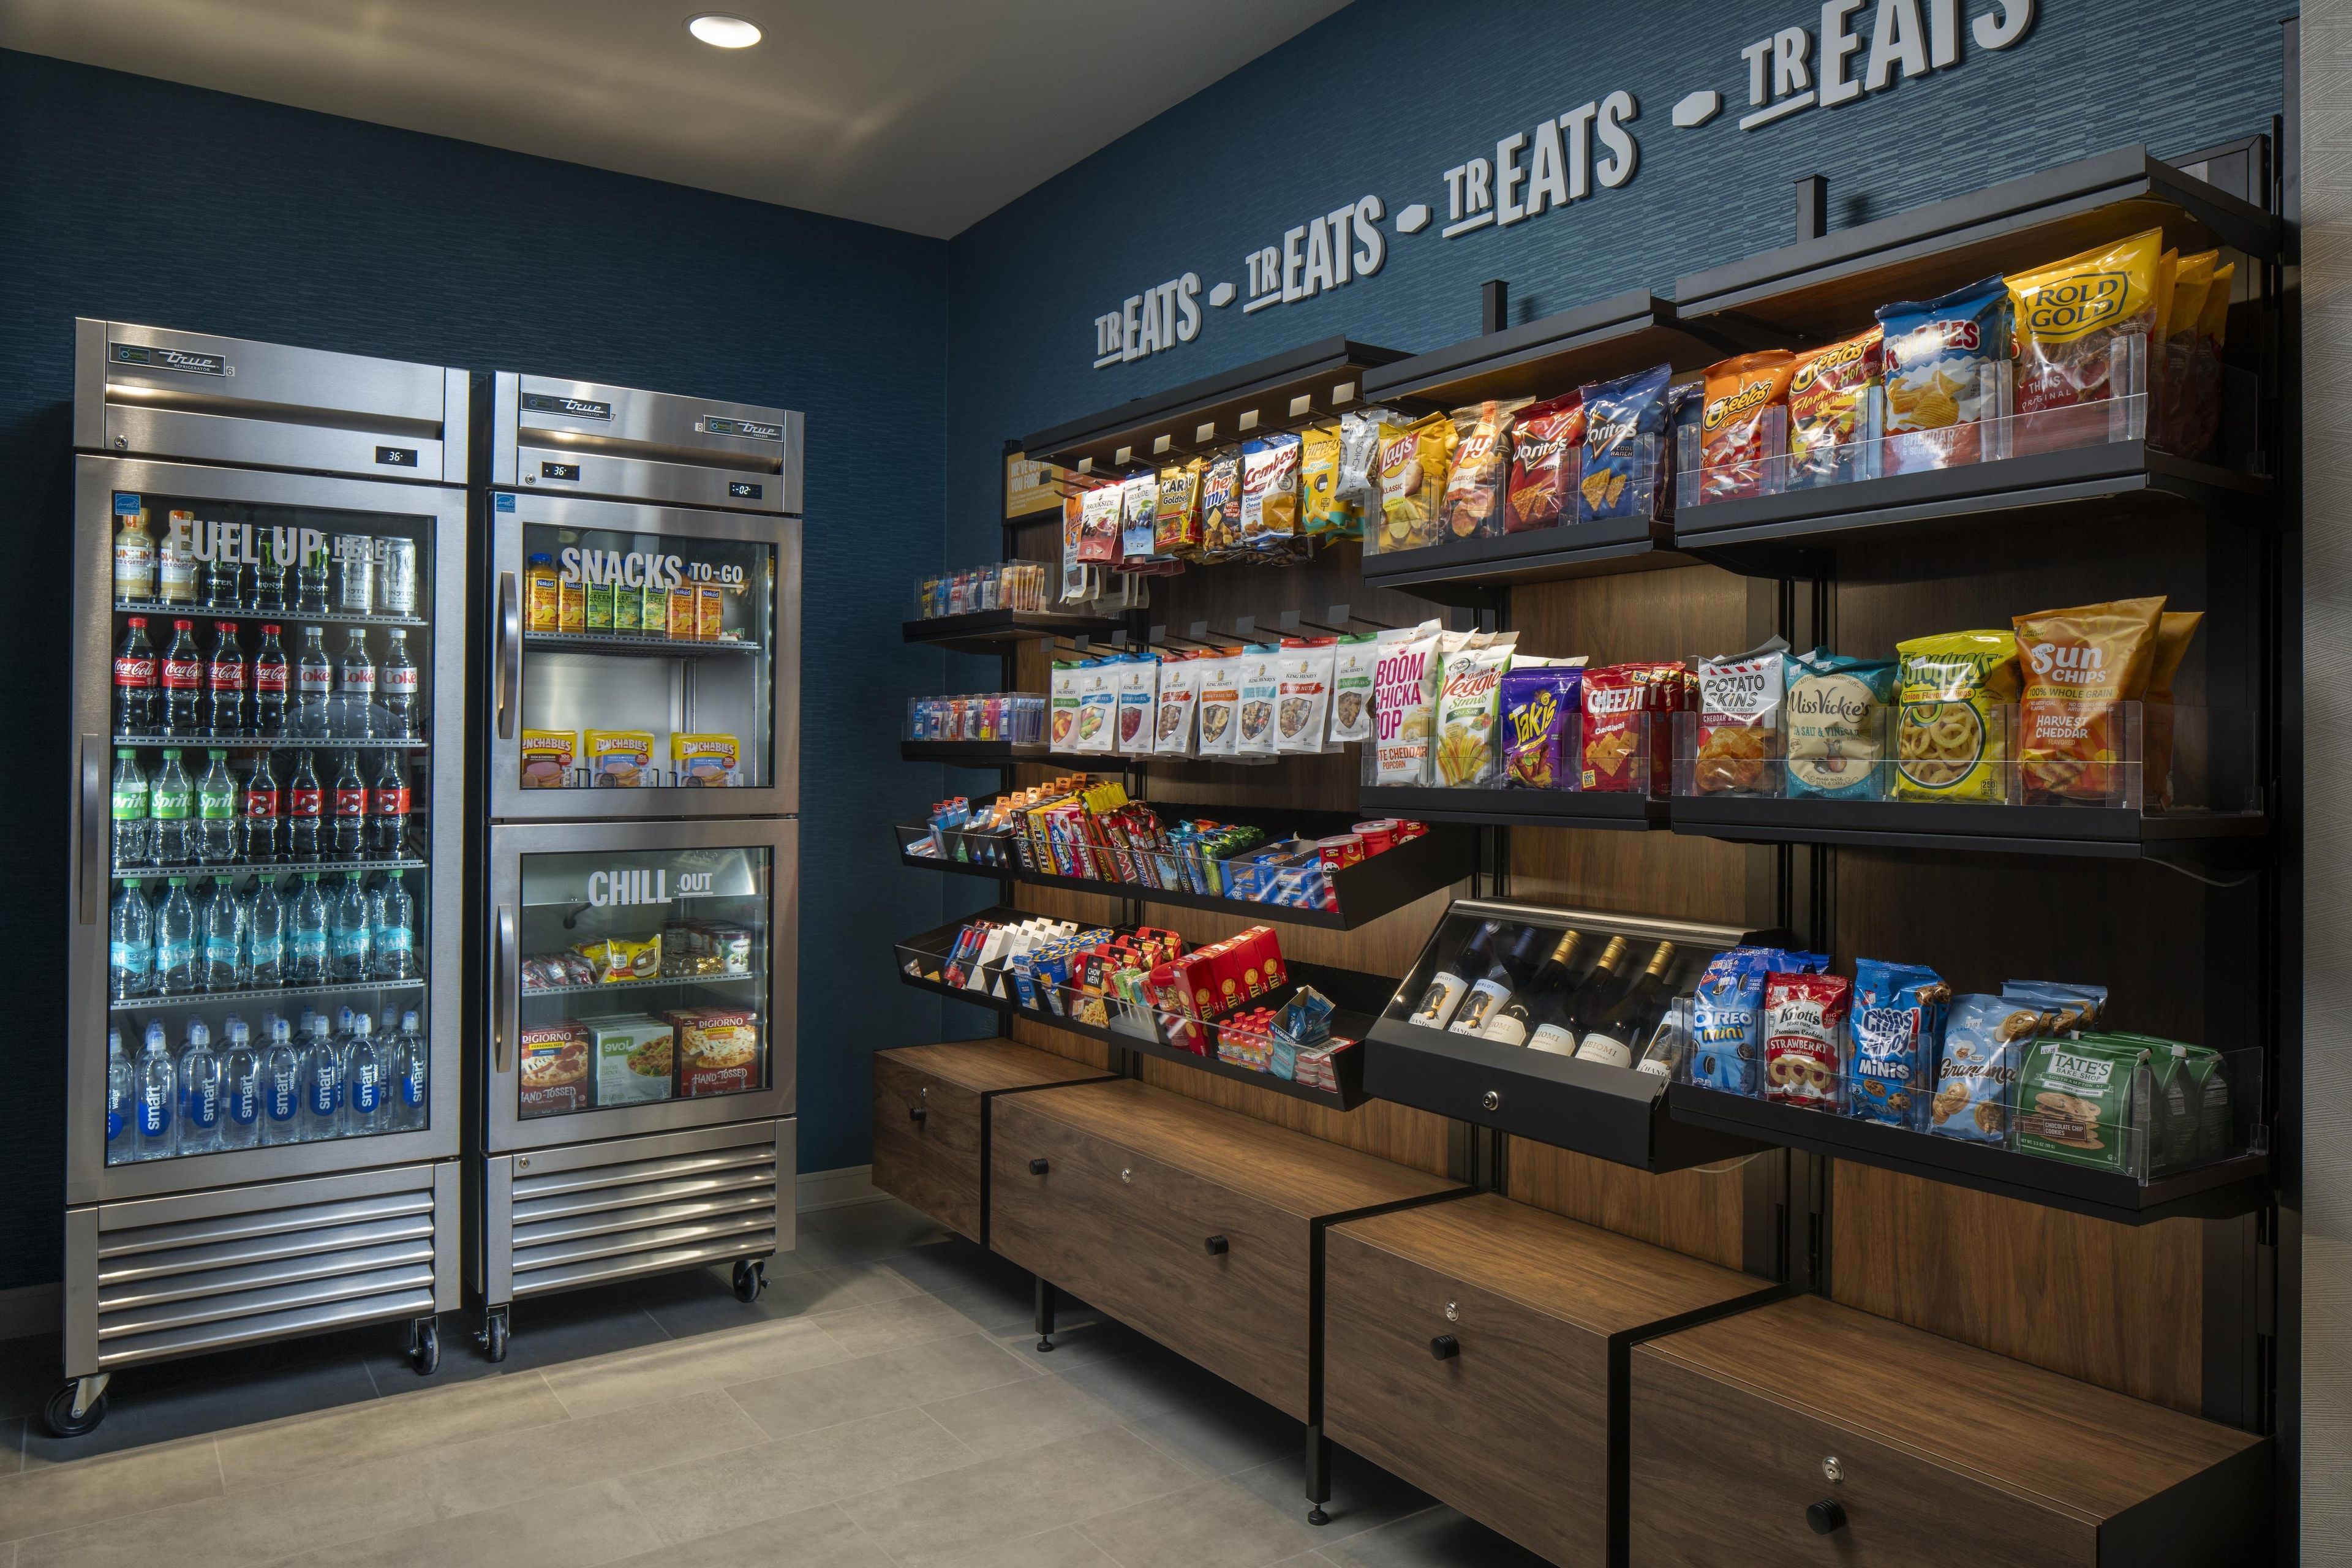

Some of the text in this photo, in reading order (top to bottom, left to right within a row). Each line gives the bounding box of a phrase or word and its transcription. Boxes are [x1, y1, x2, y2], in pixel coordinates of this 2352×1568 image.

[1095, 0, 2037, 369] TREATS TREATS TREATS TREATS
[2035, 279, 2117, 306] ROLD
[2031, 298, 2114, 327] GOLD
[174, 364, 210, 372] REFRIGERATOR
[1792, 341, 1870, 394] Cheetos
[1839, 362, 1861, 388] Hot
[1703, 382, 1773, 431] Cheetos
[2022, 388, 2071, 410] ORIGINAL
[1305, 439, 1340, 457] HIPPEAS
[1382, 433, 1414, 469] Lay's
[1349, 441, 1364, 488] PISTACHIOS
[1086, 499, 1115, 510] BROOKSIDE
[172, 519, 385, 567] FUEL UP HERE
[560, 547, 743, 589] SNACKS TO-GO
[2030, 643, 2103, 674] Sun
[1376, 652, 1426, 688] BOOM
[2051, 669, 2106, 684] CHIPS
[1440, 670, 1502, 701] Veggie
[1704, 674, 1765, 692] POTATO
[2029, 687, 2113, 698] 100% WHOLE GRAIN
[1706, 692, 1758, 707] SKINS
[1789, 686, 1872, 723] Miss Vickie's
[1509, 699, 1558, 748] Takis
[1801, 726, 1816, 736] SALT
[1817, 727, 1825, 737] &
[2036, 715, 2089, 728] HARVEST
[2035, 727, 2089, 739] CHEDDAR
[1389, 745, 1428, 761] CHEDDAR
[1382, 760, 1406, 771] POPCORN
[153, 793, 192, 810] Sprite
[588, 869, 713, 907] CHILL OUT
[1087, 967, 1101, 976] CHOW
[1087, 975, 1100, 986] MEIN
[1694, 1011, 1754, 1028] OREO
[1779, 1006, 1820, 1027] Knott's
[1275, 1027, 1291, 1042] LIQUID
[1703, 1025, 1744, 1042] mini
[1801, 1028, 1823, 1040] Cookies
[1770, 1038, 1828, 1054] STRAWBERRY
[1783, 1048, 1814, 1057] Shortbread
[2054, 1054, 2110, 1077] TATE'S
[2056, 1067, 2101, 1082] BAKE SHOP
[317, 1066, 332, 1110] smart
[360, 1063, 373, 1107] smart
[413, 1060, 424, 1103] smart
[202, 1076, 216, 1123] smart
[241, 1074, 253, 1118] smart
[274, 1071, 289, 1115] smart
[146, 1085, 161, 1131] smart
[2045, 1121, 2071, 1131] CHOCOLATE
[2045, 1128, 2065, 1137] COOKIES
